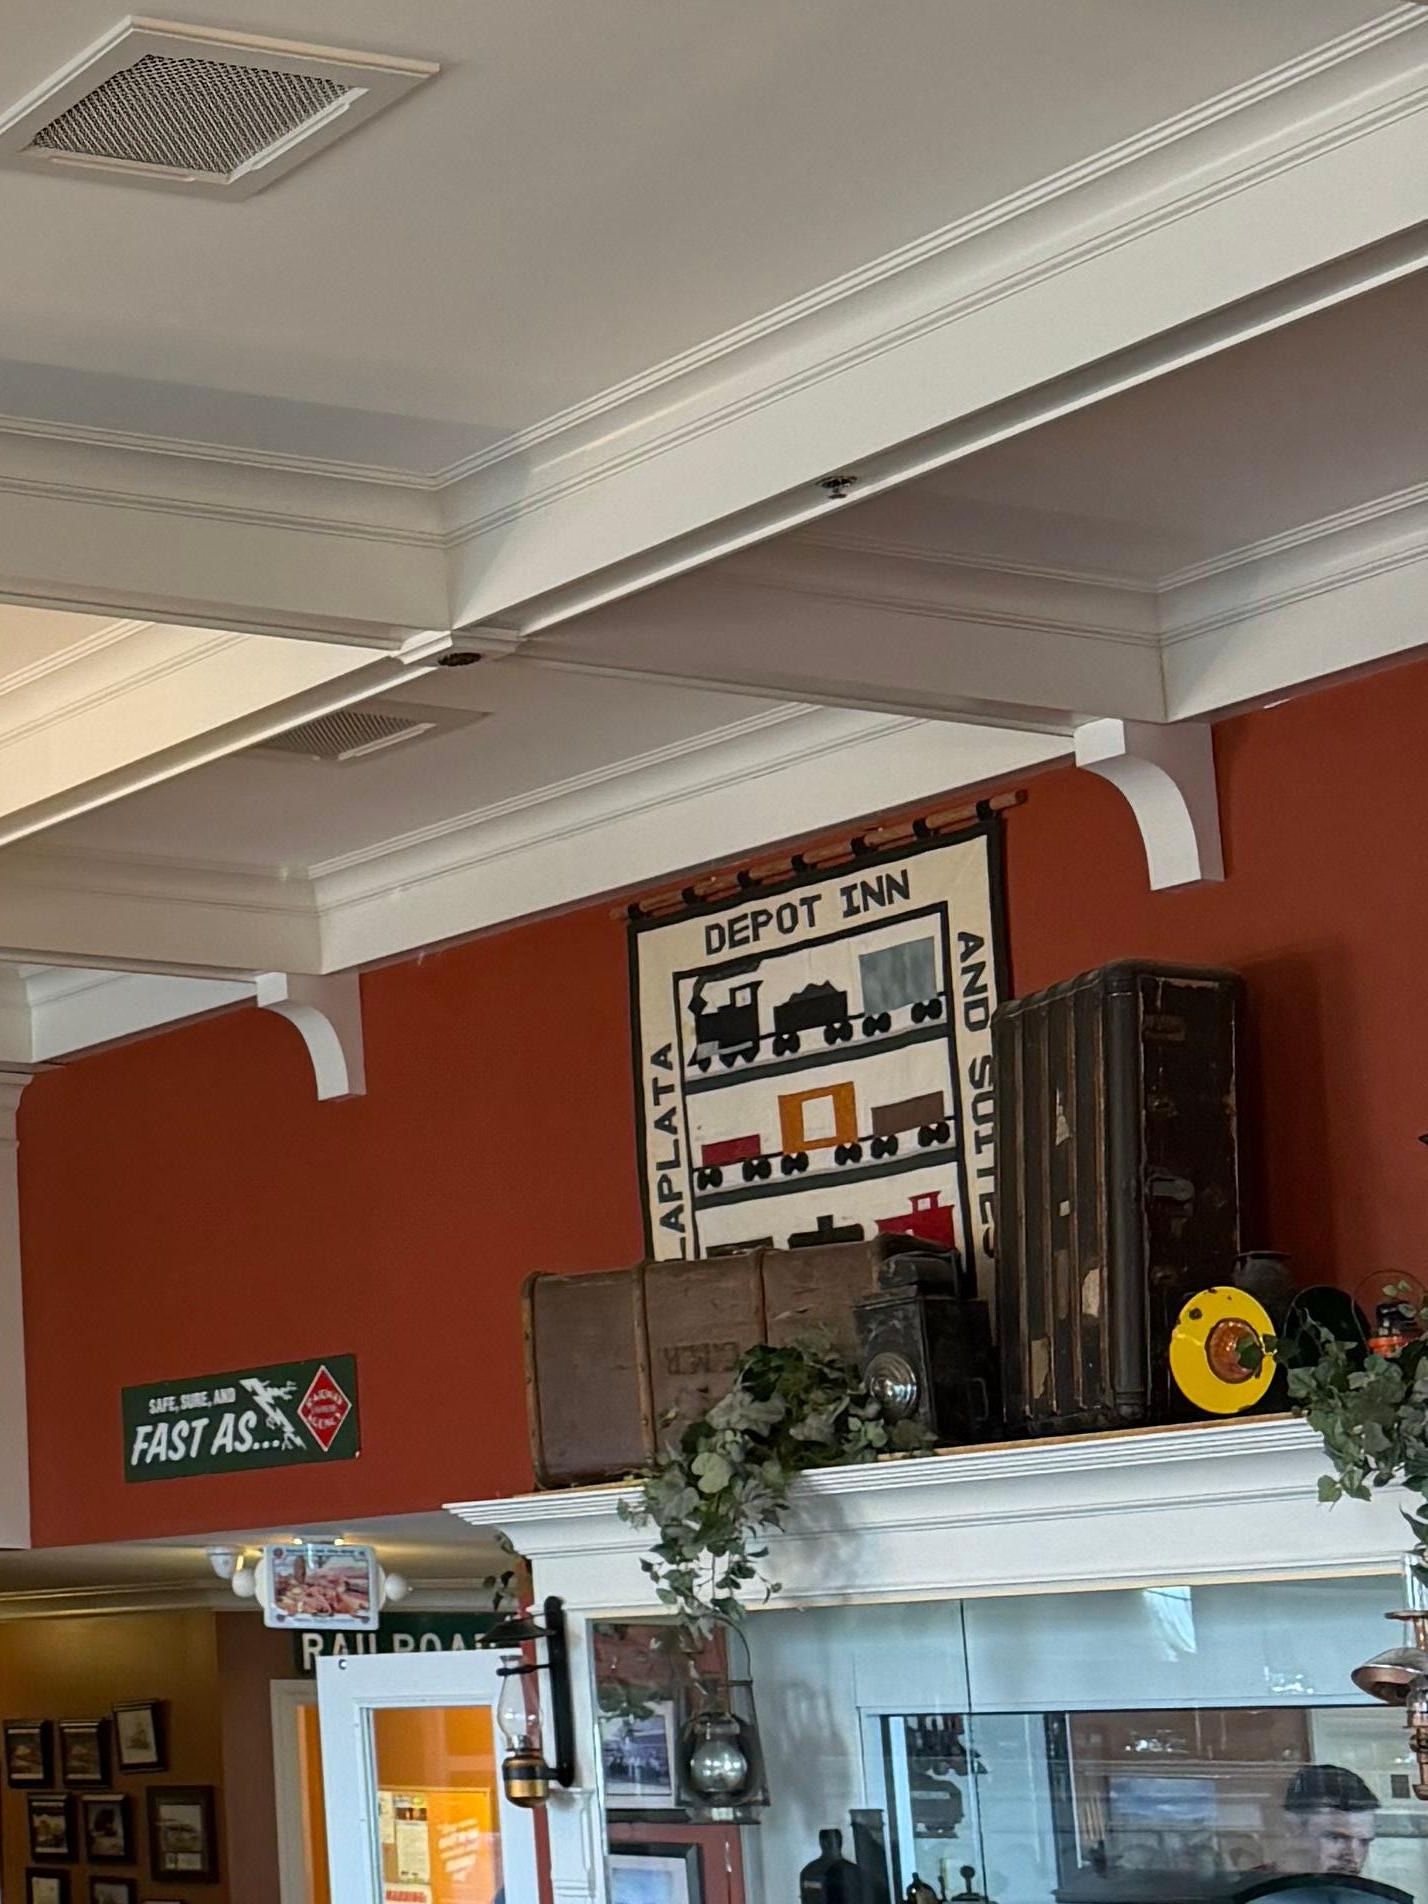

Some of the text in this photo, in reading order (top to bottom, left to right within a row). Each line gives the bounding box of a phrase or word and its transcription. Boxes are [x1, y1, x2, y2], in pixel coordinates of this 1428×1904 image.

[705, 869, 911, 956] DEPOT INN
[957, 930, 991, 1033] AND
[148, 1387, 236, 1414] SAFE, SURE, AND
[130, 1410, 281, 1466] FAST AS...
